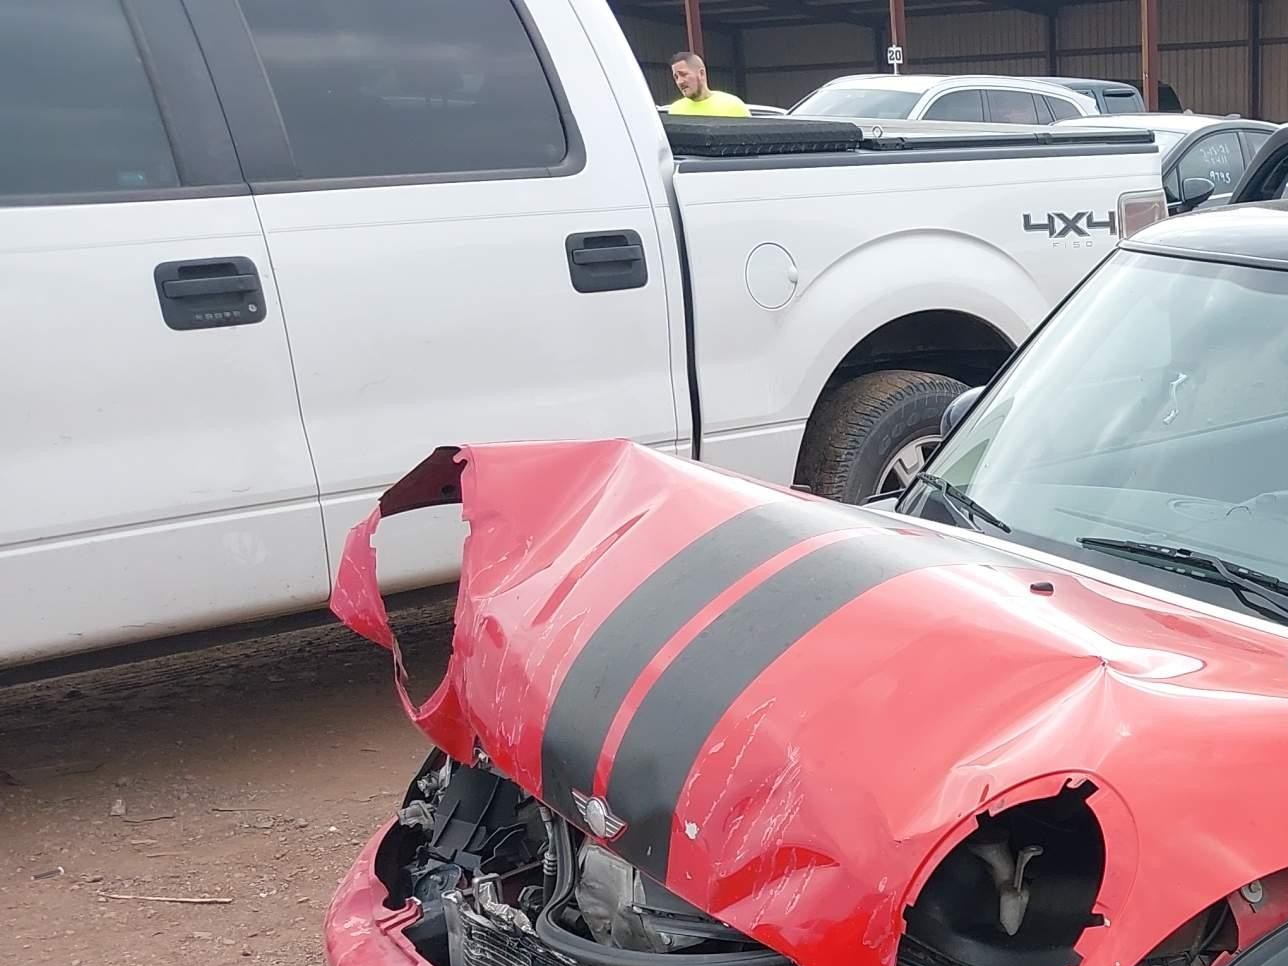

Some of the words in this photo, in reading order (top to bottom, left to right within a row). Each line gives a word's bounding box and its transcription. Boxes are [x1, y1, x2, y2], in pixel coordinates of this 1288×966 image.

[889, 50, 902, 61] 20
[1022, 211, 1117, 239] 4X4
[1052, 241, 1093, 249] F150
